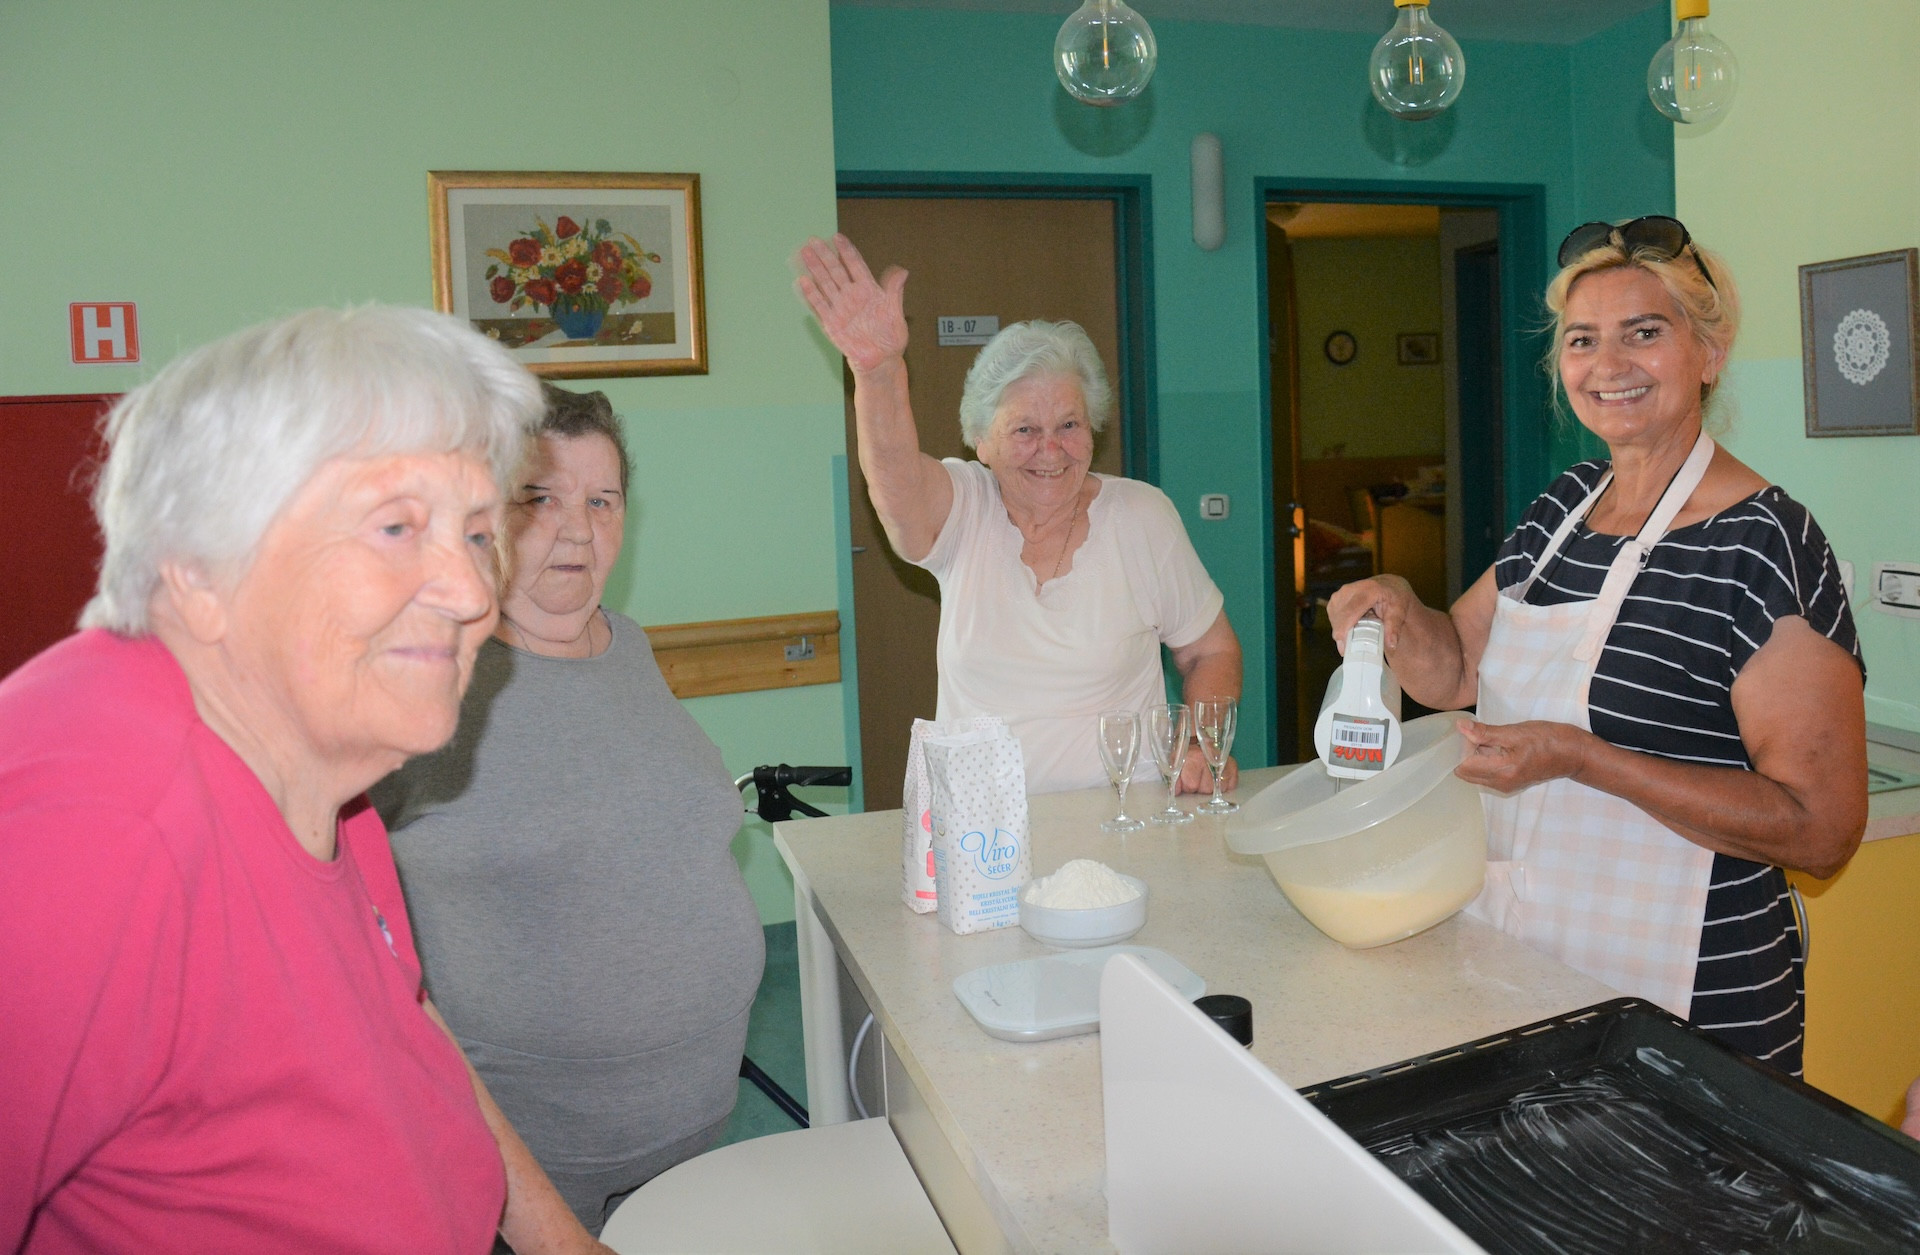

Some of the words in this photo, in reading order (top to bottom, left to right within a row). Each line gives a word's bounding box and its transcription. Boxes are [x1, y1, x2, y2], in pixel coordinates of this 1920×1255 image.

[82, 306, 128, 358] H
[964, 320, 976, 333] 07
[960, 827, 1015, 863] Viro
